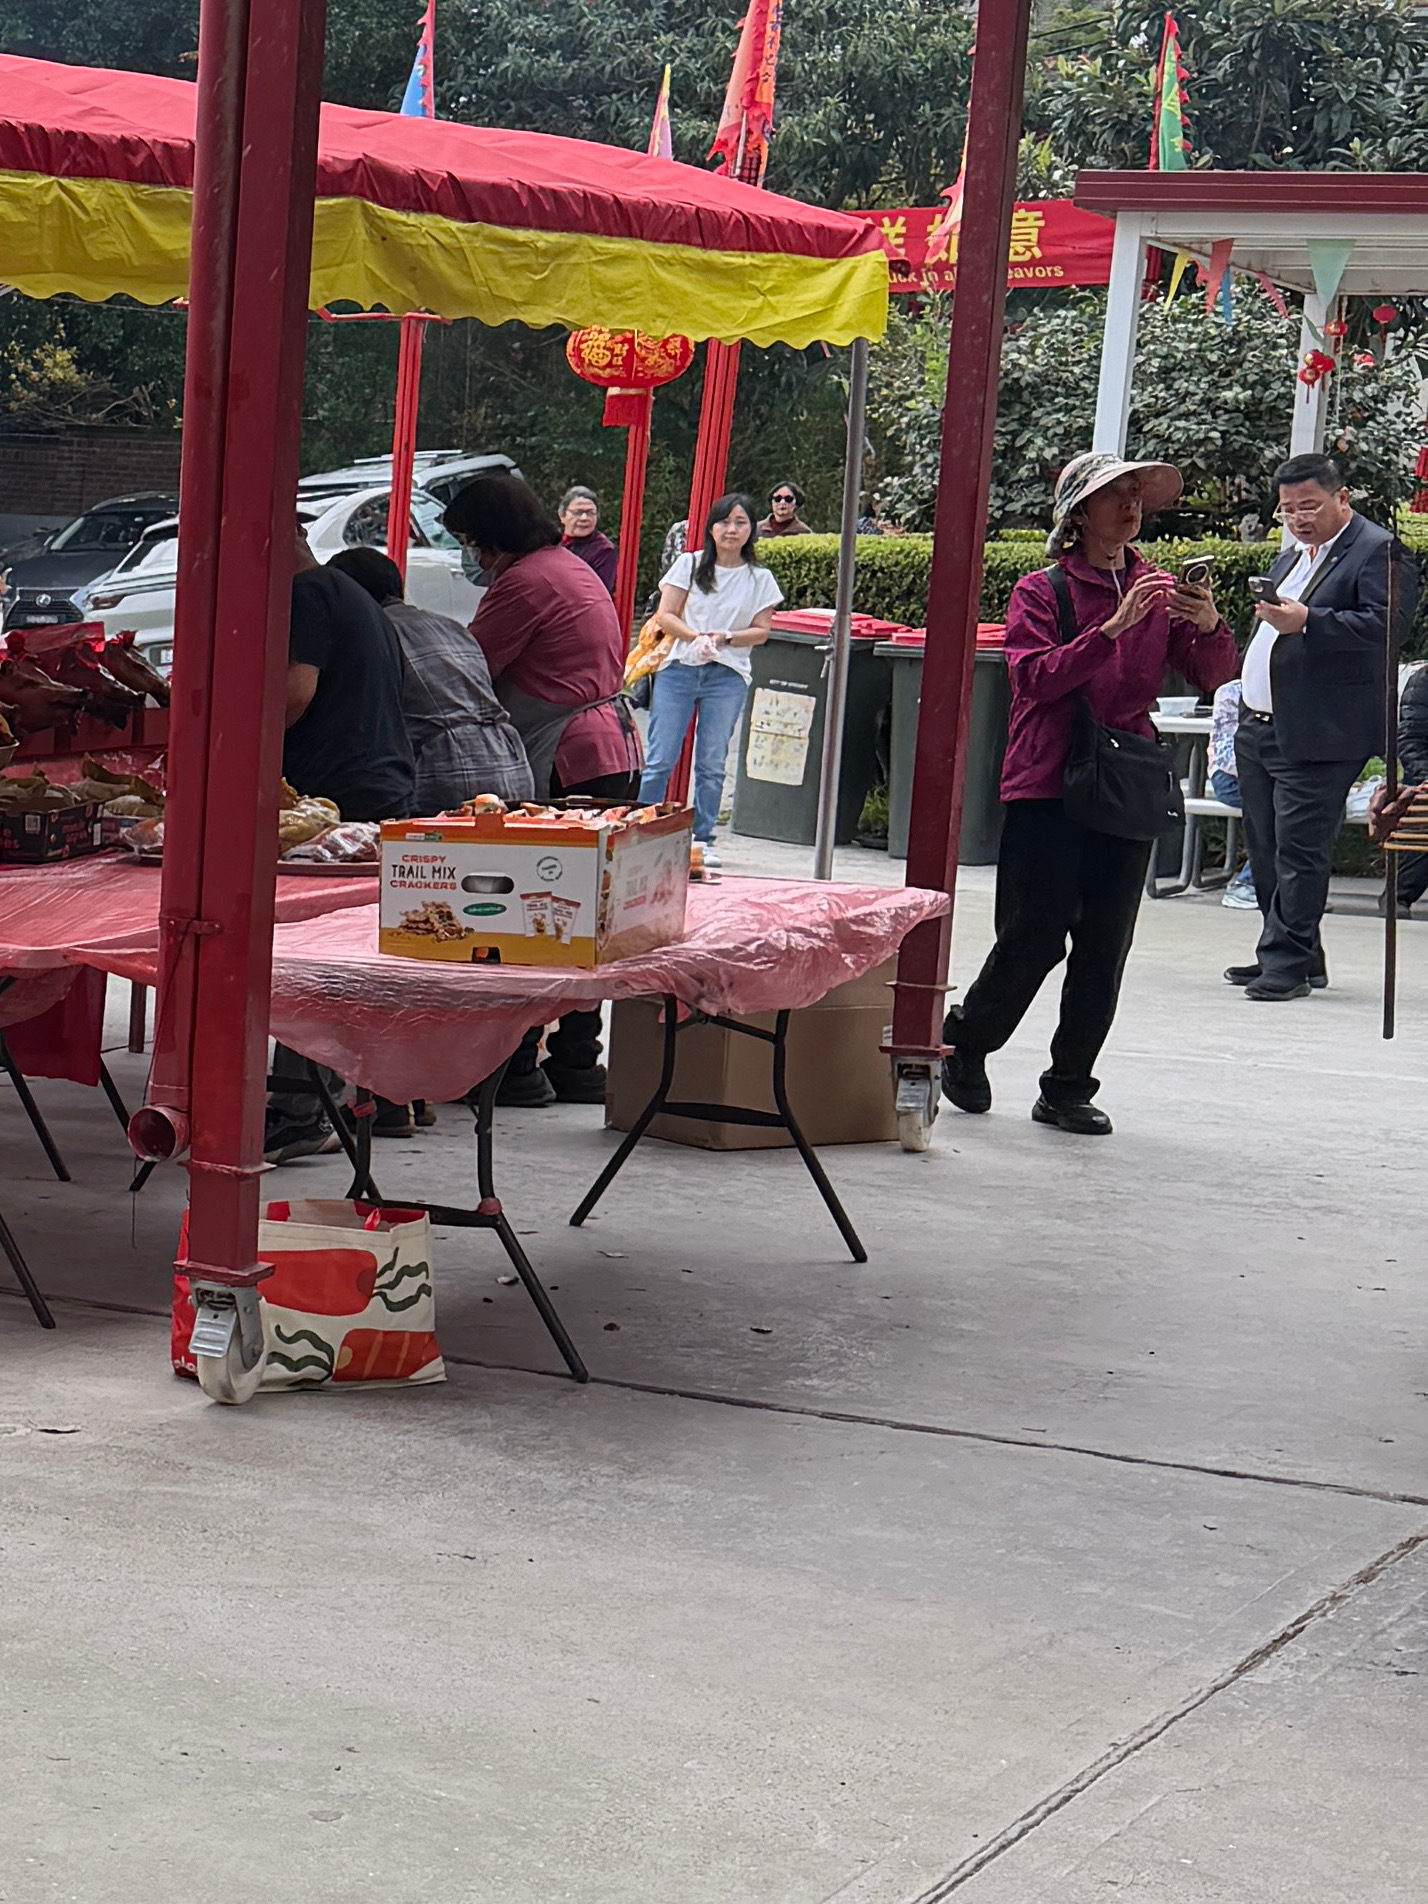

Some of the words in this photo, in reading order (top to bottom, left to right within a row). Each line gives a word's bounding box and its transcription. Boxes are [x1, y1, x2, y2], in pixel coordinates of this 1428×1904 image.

[401, 854, 448, 864] CRISPY
[391, 864, 427, 880] TRAIL
[431, 865, 456, 880] MIX
[389, 879, 458, 891] CRACKERS
